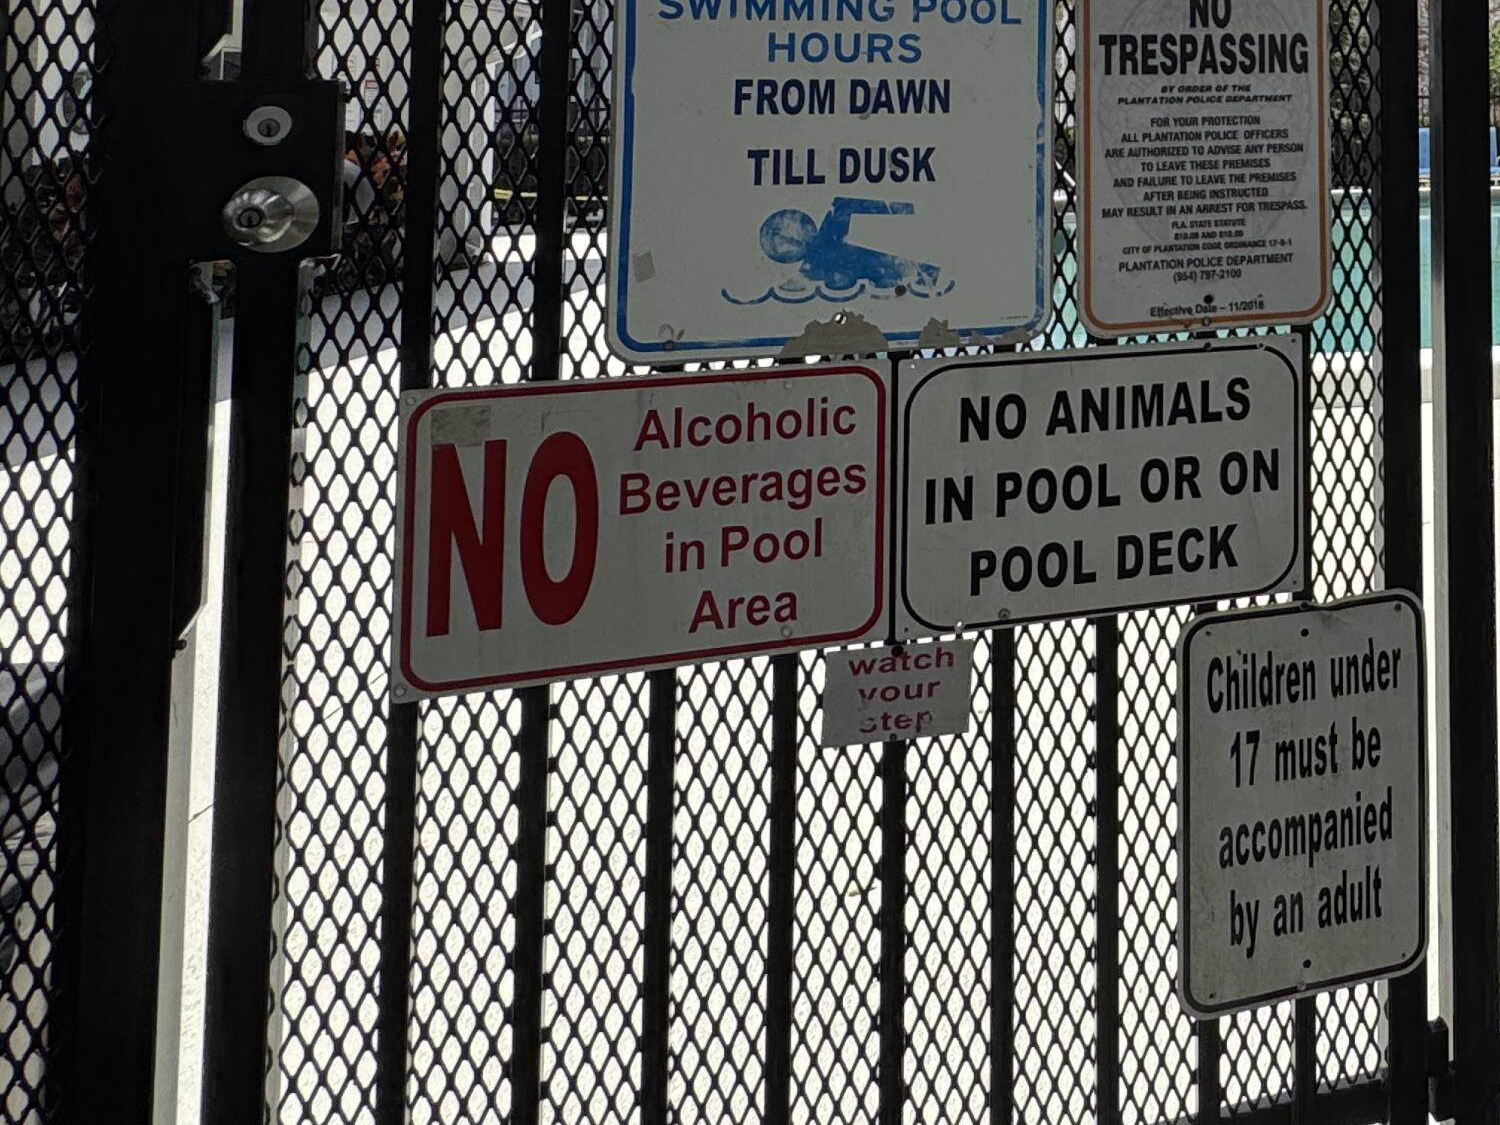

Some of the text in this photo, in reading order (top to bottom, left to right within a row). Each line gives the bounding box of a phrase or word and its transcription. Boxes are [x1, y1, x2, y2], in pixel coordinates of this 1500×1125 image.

[768, 32, 922, 63] HOURS
[1099, 33, 1309, 75] TRESPASSING
[734, 79, 950, 115] FROM DAWN
[1118, 94, 1292, 105] PLANTATION POLICE DEPARTMENT
[1161, 84, 1251, 93] BY ORDER OF THE
[1121, 129, 1288, 143] ALL PLANTATION POLICE OFFICERS
[1151, 116, 1260, 127] FOR YOUR PROTECTION
[747, 147, 936, 186] TILL DUSK
[1105, 144, 1303, 158] ARE AUTHORIZED TO ADVISE ANY PERSON
[1141, 159, 1270, 172] TO LEAVE THESE PREMISES
[1113, 173, 1296, 188] AND FAILURE TO LEAVE THE PREMISES
[1143, 188, 1268, 202] AFTER BEING INSTRUCTED
[1102, 201, 1308, 218] MAY RESULT IN AN ARREST FOR TRESPASS.
[1119, 253, 1293, 272] PLANTATION POLICE DEPARTMENT
[1123, 246, 1140, 255] CITY
[1143, 246, 1152, 254] OF
[1154, 244, 1200, 253] PLANTATION
[1202, 242, 1222, 251] CODE
[1173, 273, 1197, 283] (954)
[1151, 305, 1193, 318] Effective
[1196, 303, 1217, 314] Date
[633, 397, 857, 452] Alcoholic
[959, 376, 1252, 443] NO ANIMALS
[619, 463, 867, 516] Beverages
[925, 447, 1280, 525] IN POOL OR ON
[426, 431, 599, 638] NO
[665, 517, 823, 573] in Pool
[970, 523, 1239, 597] POOL DECK
[688, 590, 799, 634] Area
[849, 647, 954, 675] watch
[1206, 637, 1401, 714] Children under
[1230, 716, 1382, 788] 17 must be
[1219, 786, 1393, 869] accompanied
[1230, 865, 1383, 959] by an adult
